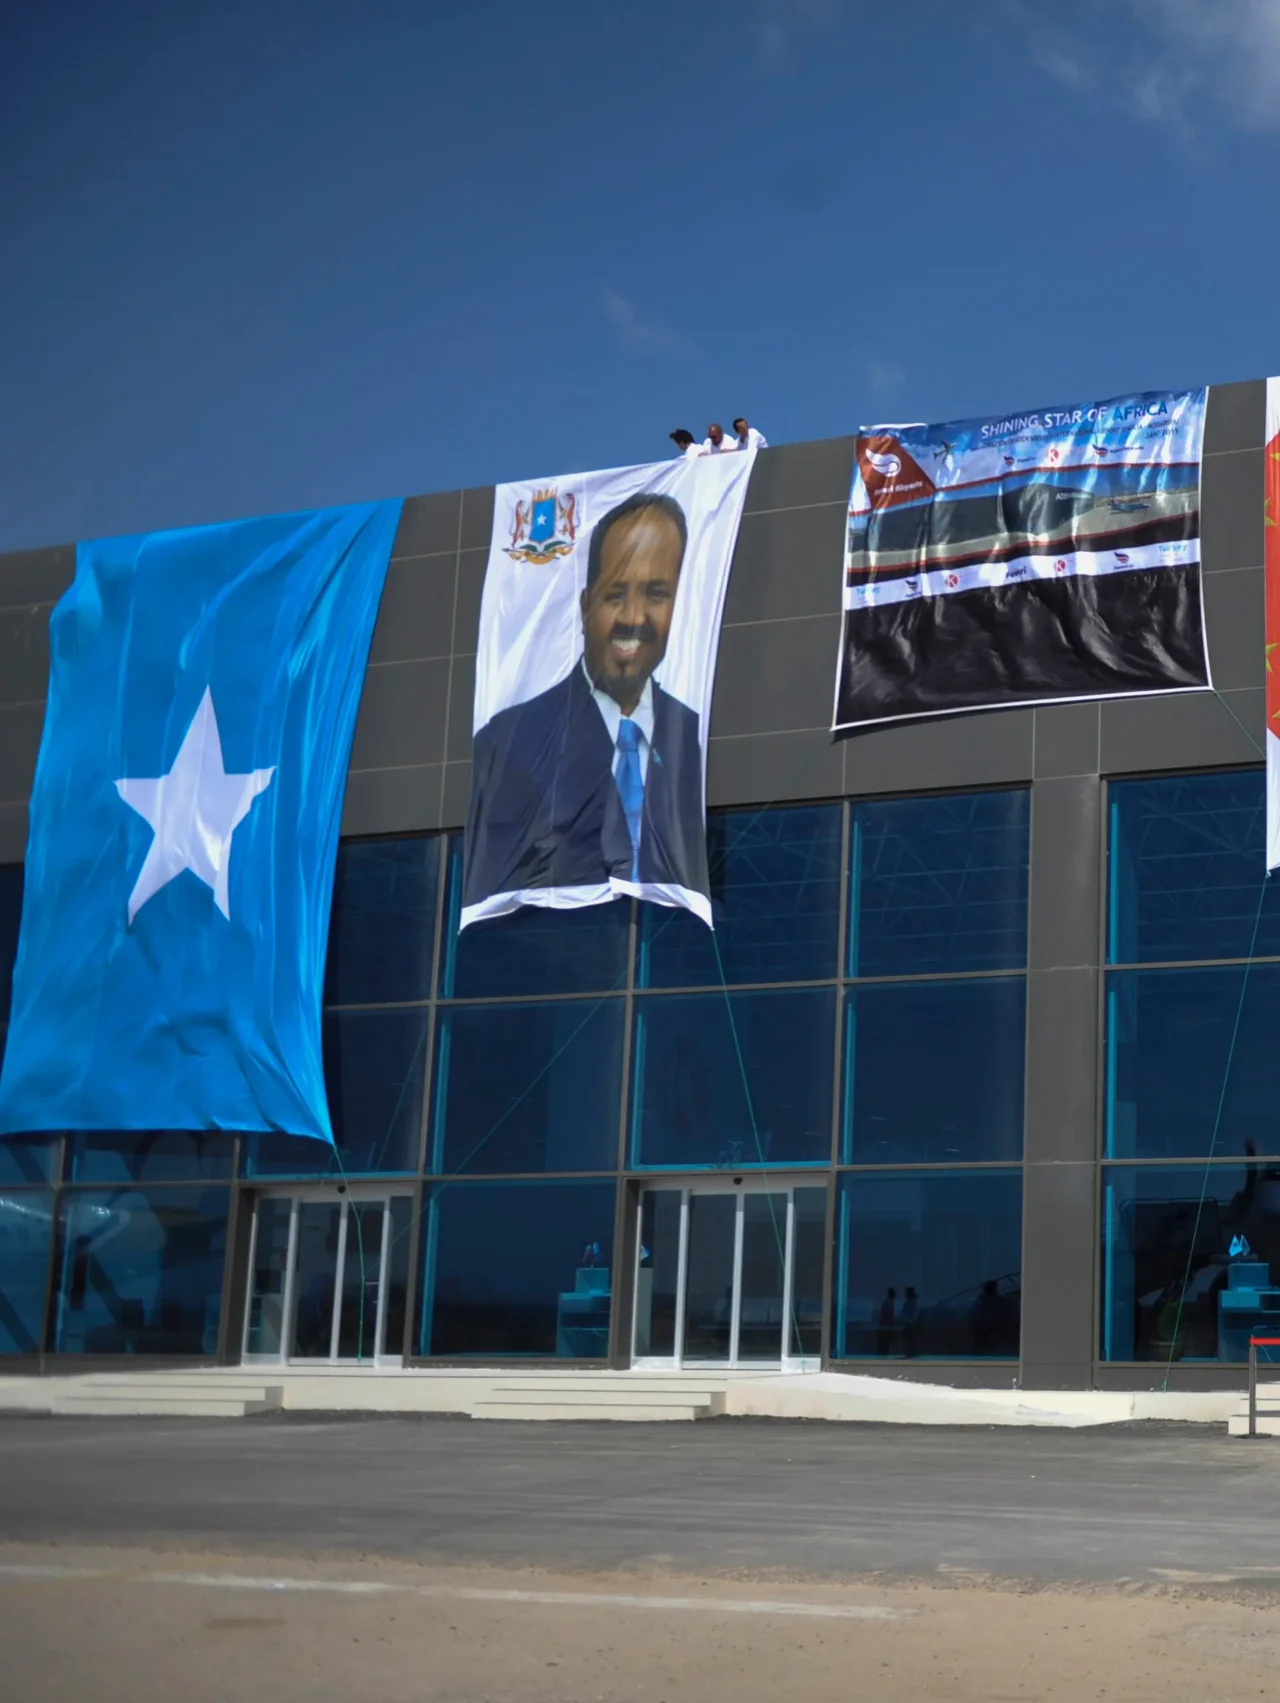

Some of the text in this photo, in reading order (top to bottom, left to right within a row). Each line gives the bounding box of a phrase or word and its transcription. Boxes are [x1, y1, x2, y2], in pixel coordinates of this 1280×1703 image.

[981, 400, 1168, 439] SHINING STAR OF AFRICA
